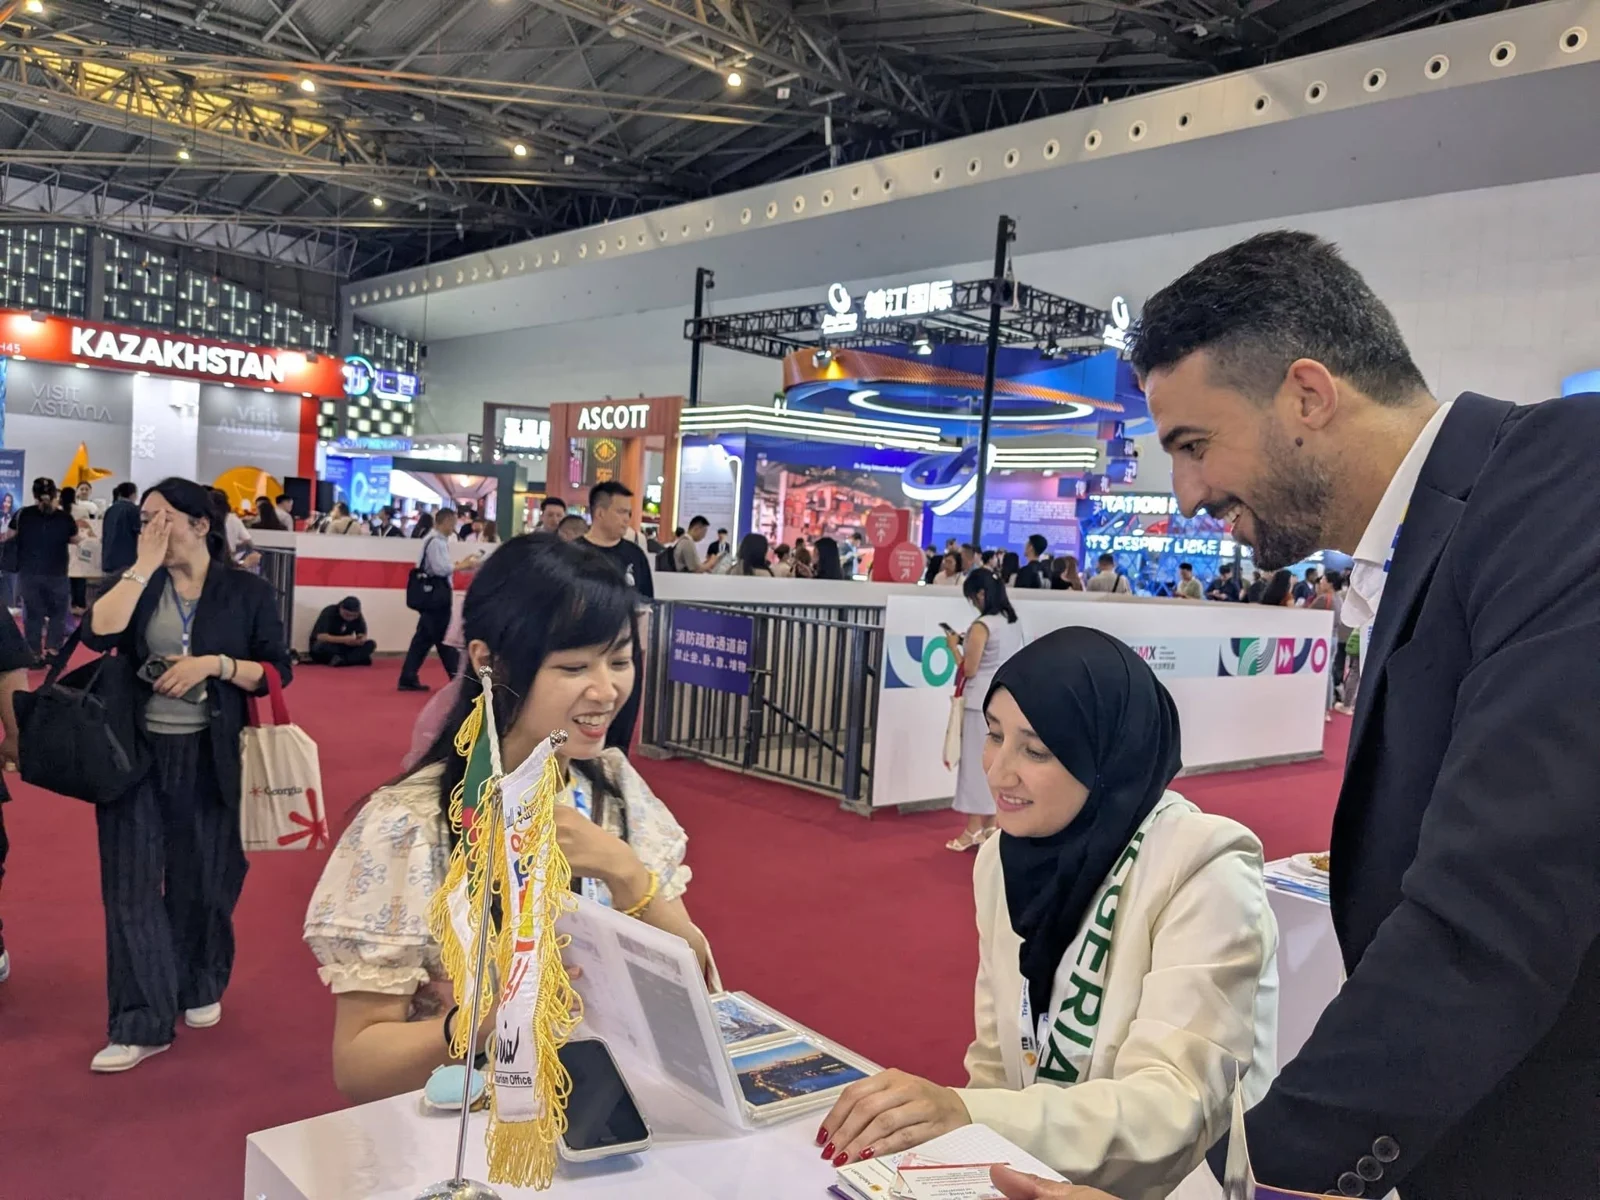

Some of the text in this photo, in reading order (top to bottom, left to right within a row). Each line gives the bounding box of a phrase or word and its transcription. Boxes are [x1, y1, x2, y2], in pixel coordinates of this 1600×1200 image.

[71, 327, 285, 383] KAZAKHSTAN
[31, 382, 80, 400] VISIT
[236, 405, 280, 426] Visit
[577, 404, 650, 431] ASCOTT
[216, 417, 285, 442] Almaty
[264, 787, 303, 796] Georgia
[510, 1075, 532, 1086] Office
